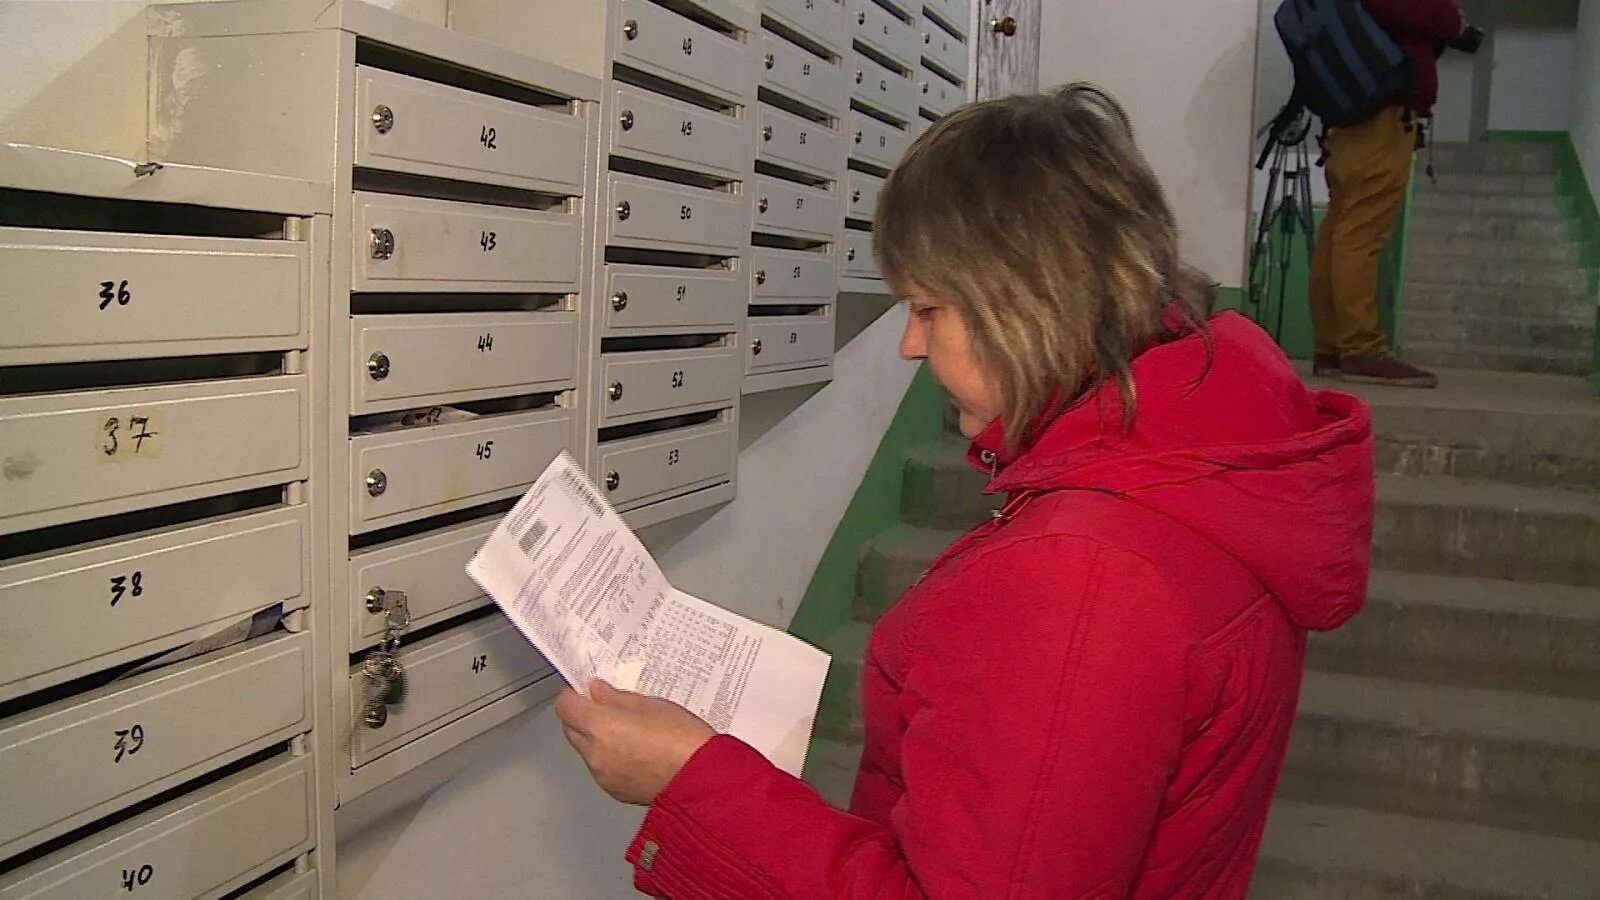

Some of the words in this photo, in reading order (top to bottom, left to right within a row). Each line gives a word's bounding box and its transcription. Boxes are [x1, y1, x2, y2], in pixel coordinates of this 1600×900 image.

[682, 37, 692, 56] 48
[480, 125, 497, 150] 42
[680, 120, 692, 137] 49
[680, 205, 691, 221] 50
[480, 230, 497, 252] 43
[98, 279, 131, 311] 36
[676, 285, 686, 302] 51
[477, 332, 493, 353] 44
[672, 370, 684, 389] 52
[104, 416, 158, 456] 37
[475, 440, 494, 461] 45
[668, 449, 679, 466] 53
[110, 570, 143, 607] 38
[471, 654, 487, 674] 47
[113, 724, 144, 764] 39
[122, 864, 154, 892] 40
